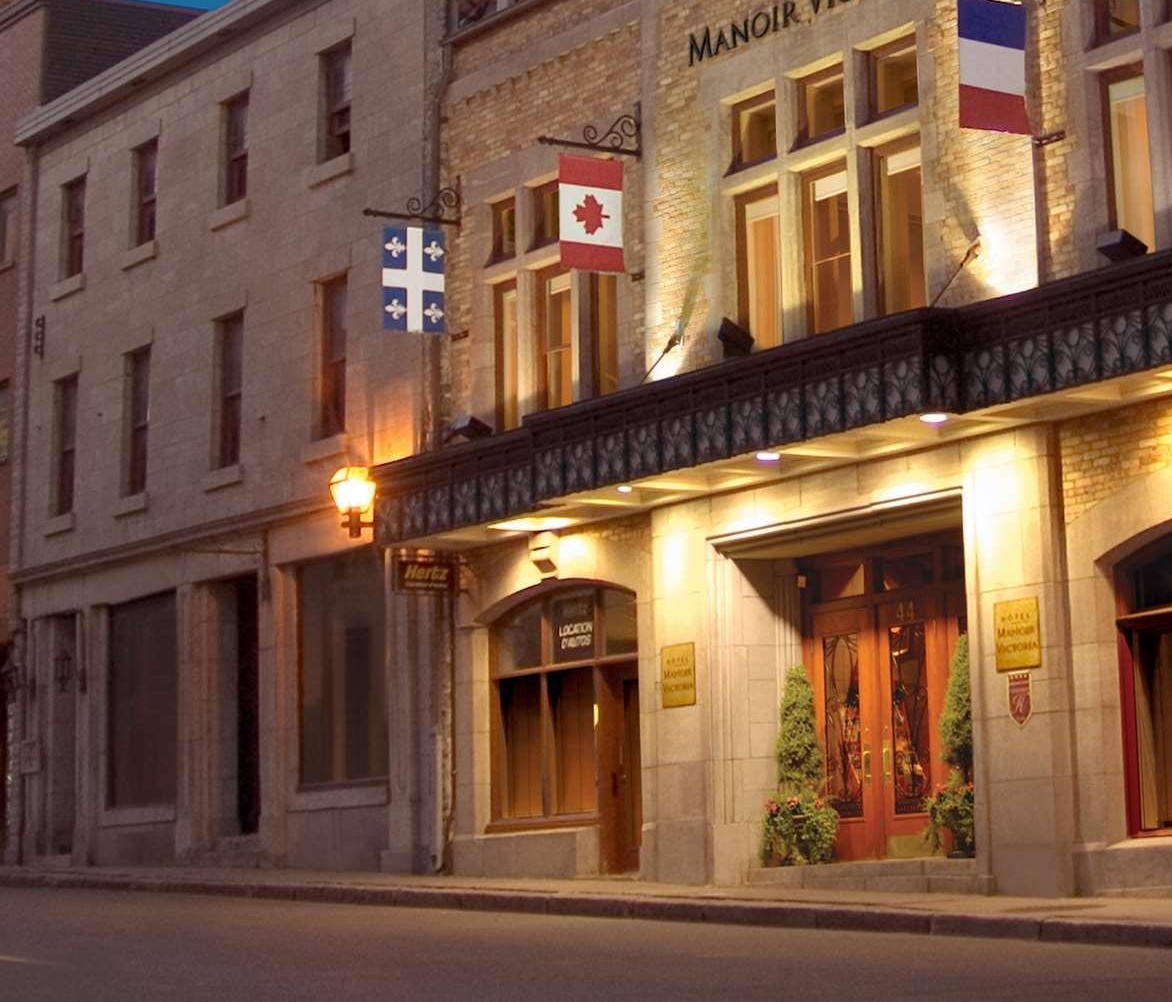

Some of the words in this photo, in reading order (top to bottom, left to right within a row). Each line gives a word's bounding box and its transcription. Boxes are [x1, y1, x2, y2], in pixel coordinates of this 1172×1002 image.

[688, 1, 800, 67] MANOIR
[404, 564, 449, 581] Hertz
[559, 622, 594, 637] LOCATION
